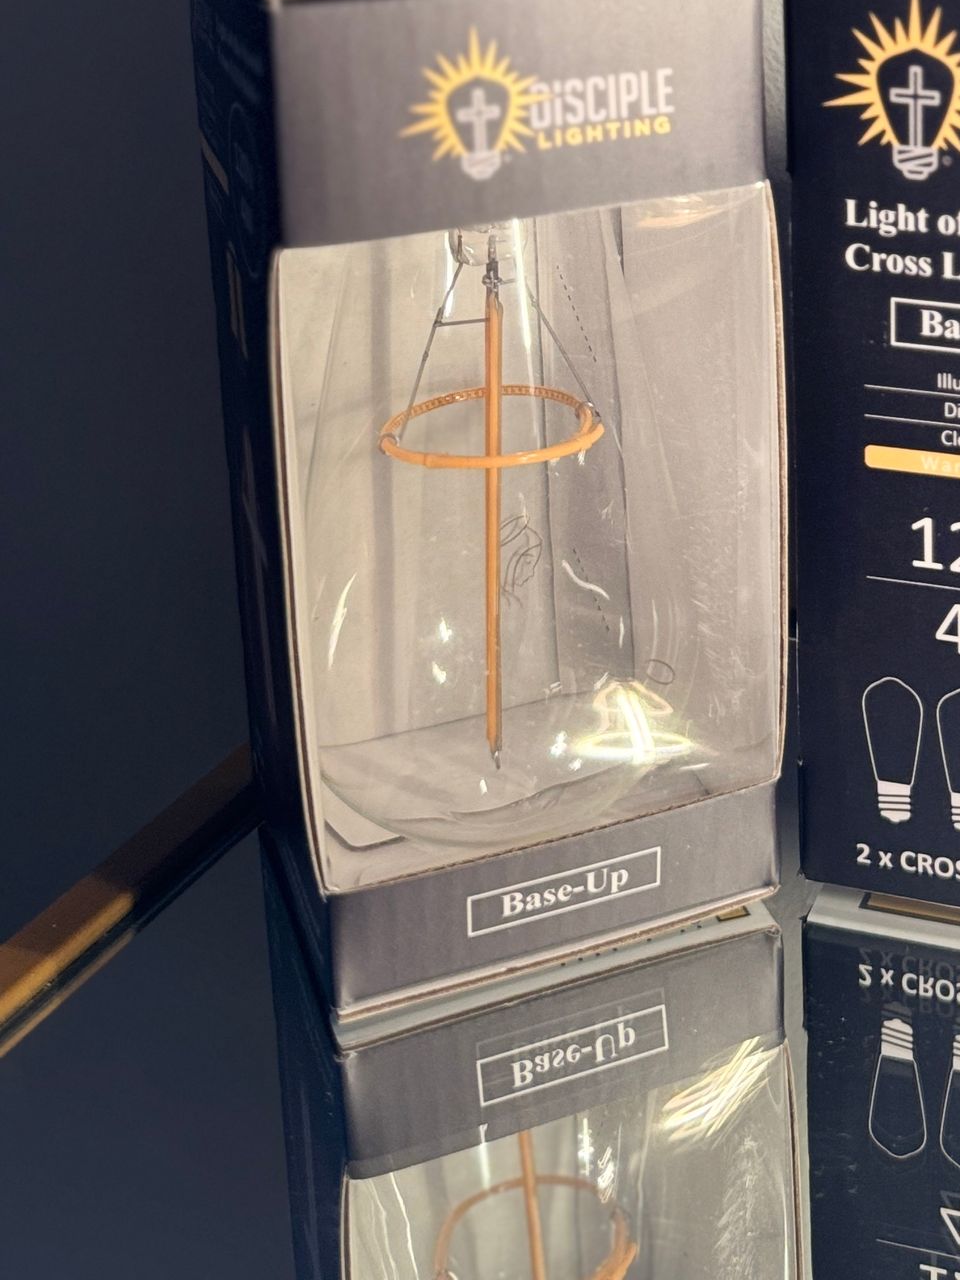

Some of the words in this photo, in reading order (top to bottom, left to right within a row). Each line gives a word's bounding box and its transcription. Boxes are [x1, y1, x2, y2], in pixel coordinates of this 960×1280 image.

[537, 115, 672, 150] LIGHTING
[844, 198, 929, 238] Light
[844, 243, 933, 278] Cross
[856, 842, 872, 866] 2
[878, 850, 893, 870] x
[501, 867, 629, 919] Base-Up
